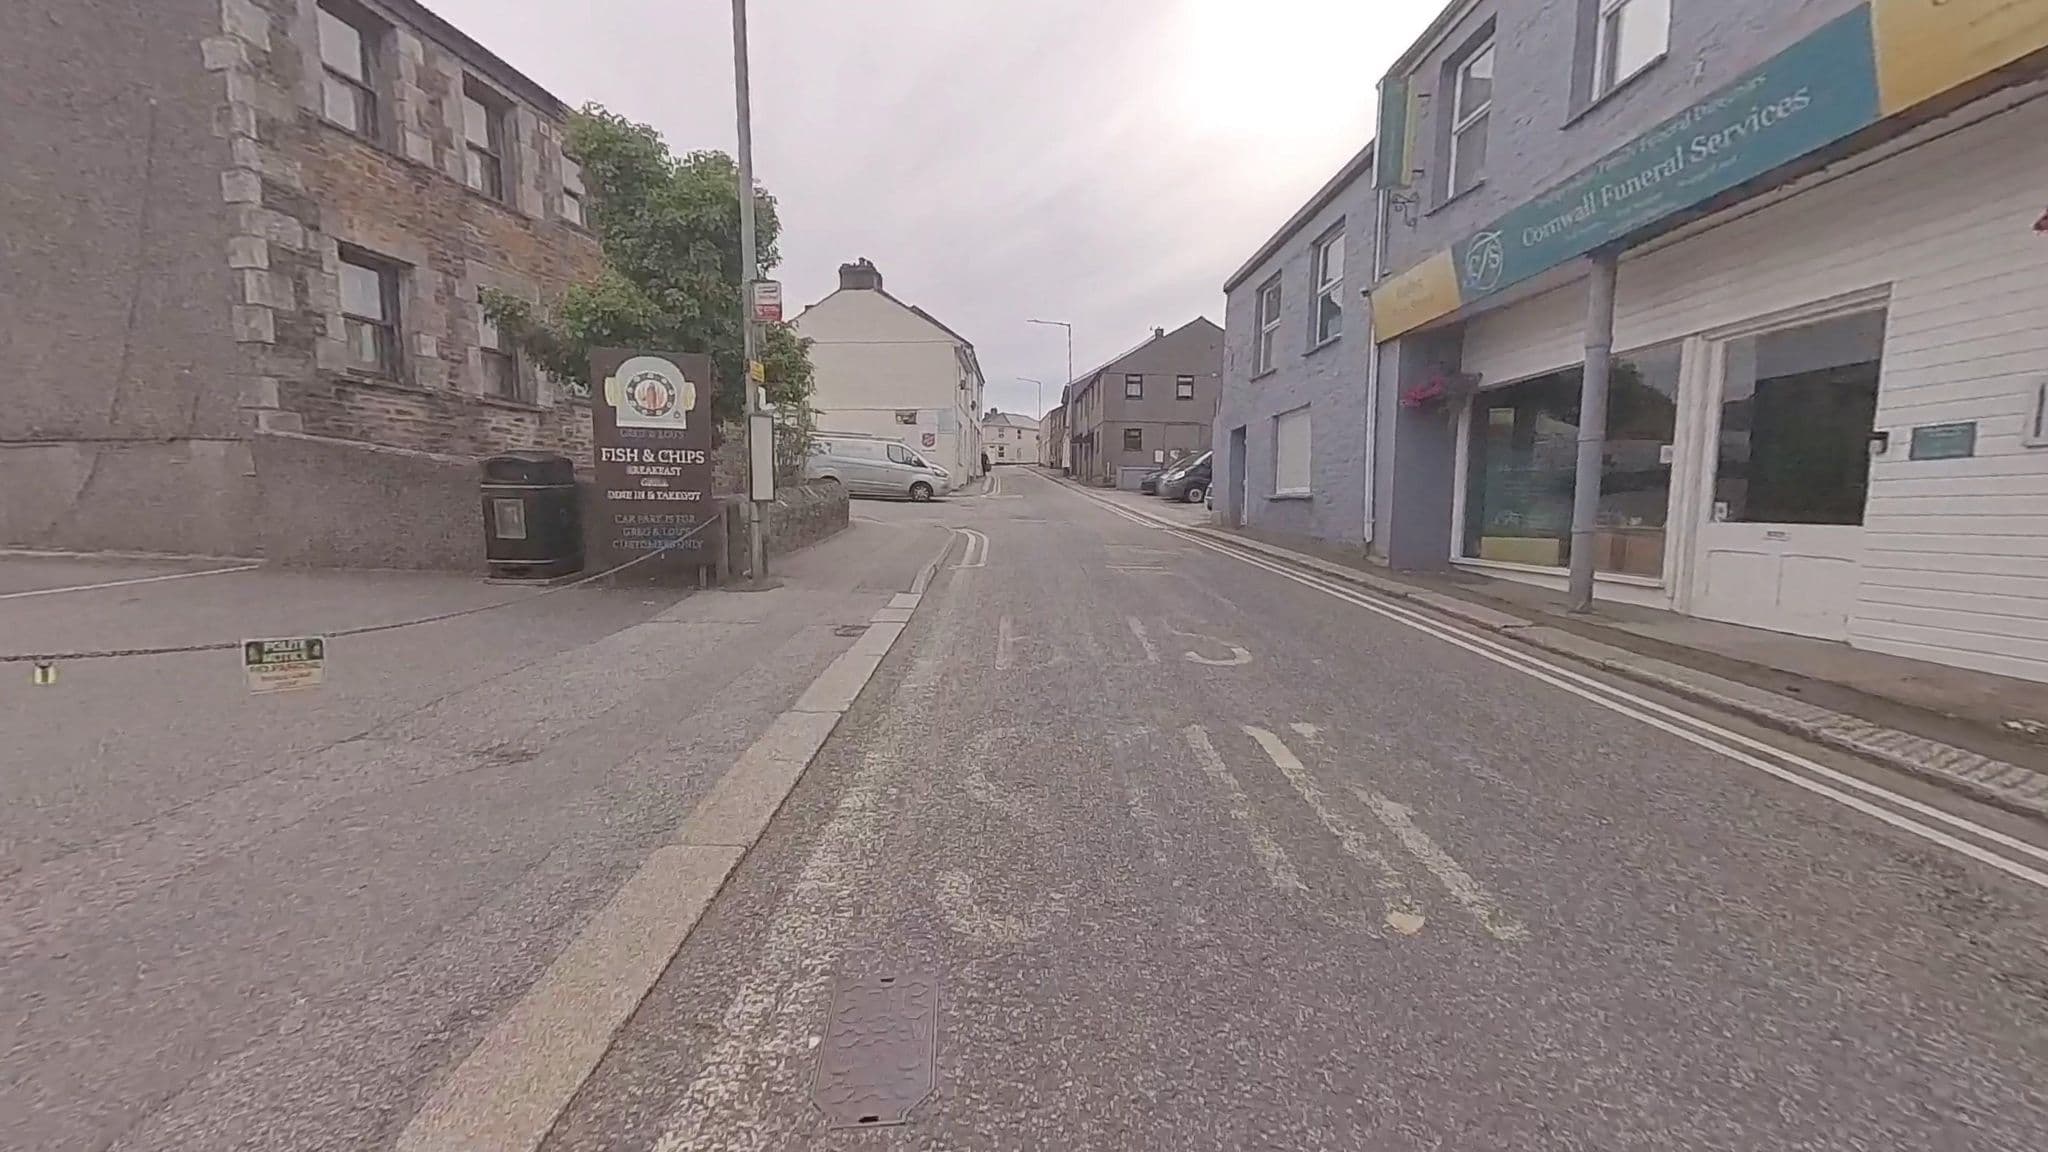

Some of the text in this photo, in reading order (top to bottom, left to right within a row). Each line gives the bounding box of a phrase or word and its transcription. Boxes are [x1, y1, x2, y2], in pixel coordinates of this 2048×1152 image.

[1521, 192, 1596, 248] Cornwall
[1600, 147, 1684, 208] Funeral
[1690, 86, 1811, 164] Services
[601, 448, 705, 464] FISH & CHIPS
[626, 465, 682, 476] BREAKFAST
[607, 490, 633, 500] DINE
[634, 490, 646, 500] IN
[614, 514, 696, 524] CAR PARK IS FOR
[612, 540, 678, 549] CUSTOMES
